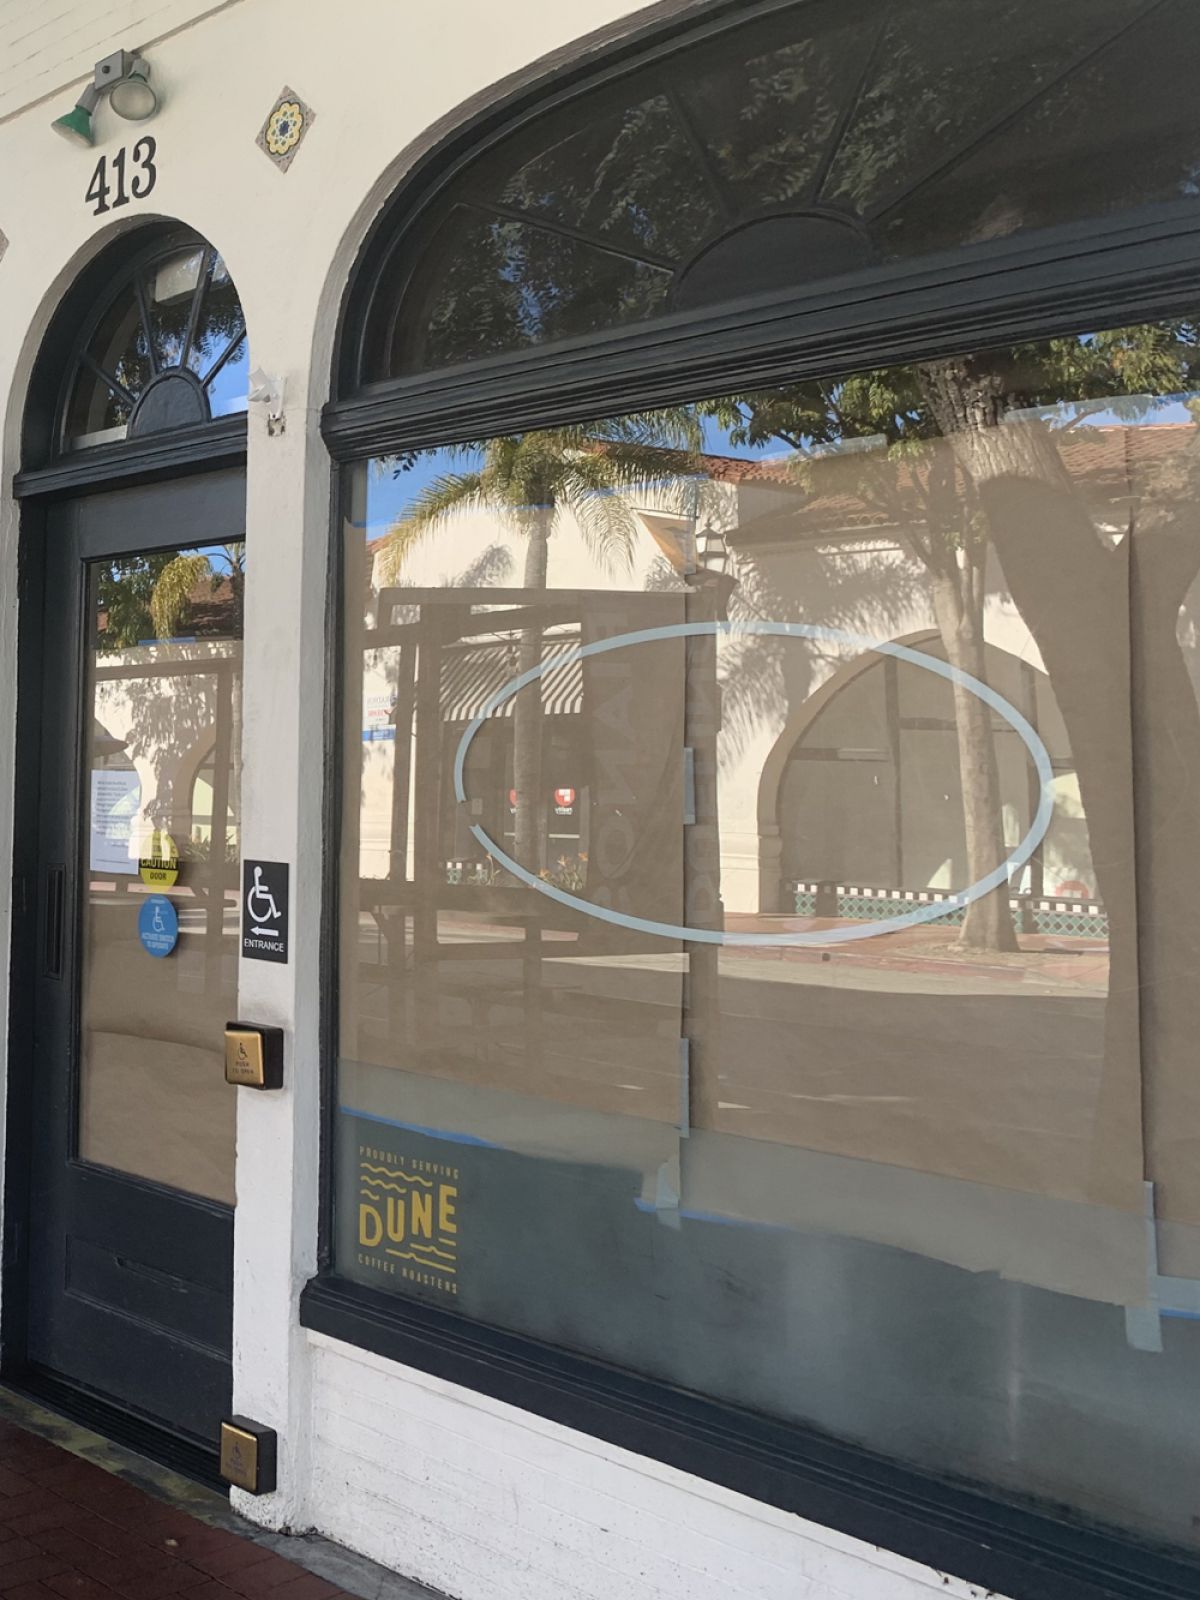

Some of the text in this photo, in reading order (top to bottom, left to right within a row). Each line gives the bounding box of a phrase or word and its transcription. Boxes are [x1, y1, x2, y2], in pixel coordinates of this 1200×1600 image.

[85, 135, 157, 216] 413
[140, 857, 177, 869] CAUTION
[149, 871, 167, 880] DOOR
[244, 938, 285, 952] ENTRANCE
[359, 1145, 459, 1180] PROUDLY SERVING
[359, 1184, 457, 1247] DUNE
[358, 1253, 457, 1294] COFFEE ROASTERS
